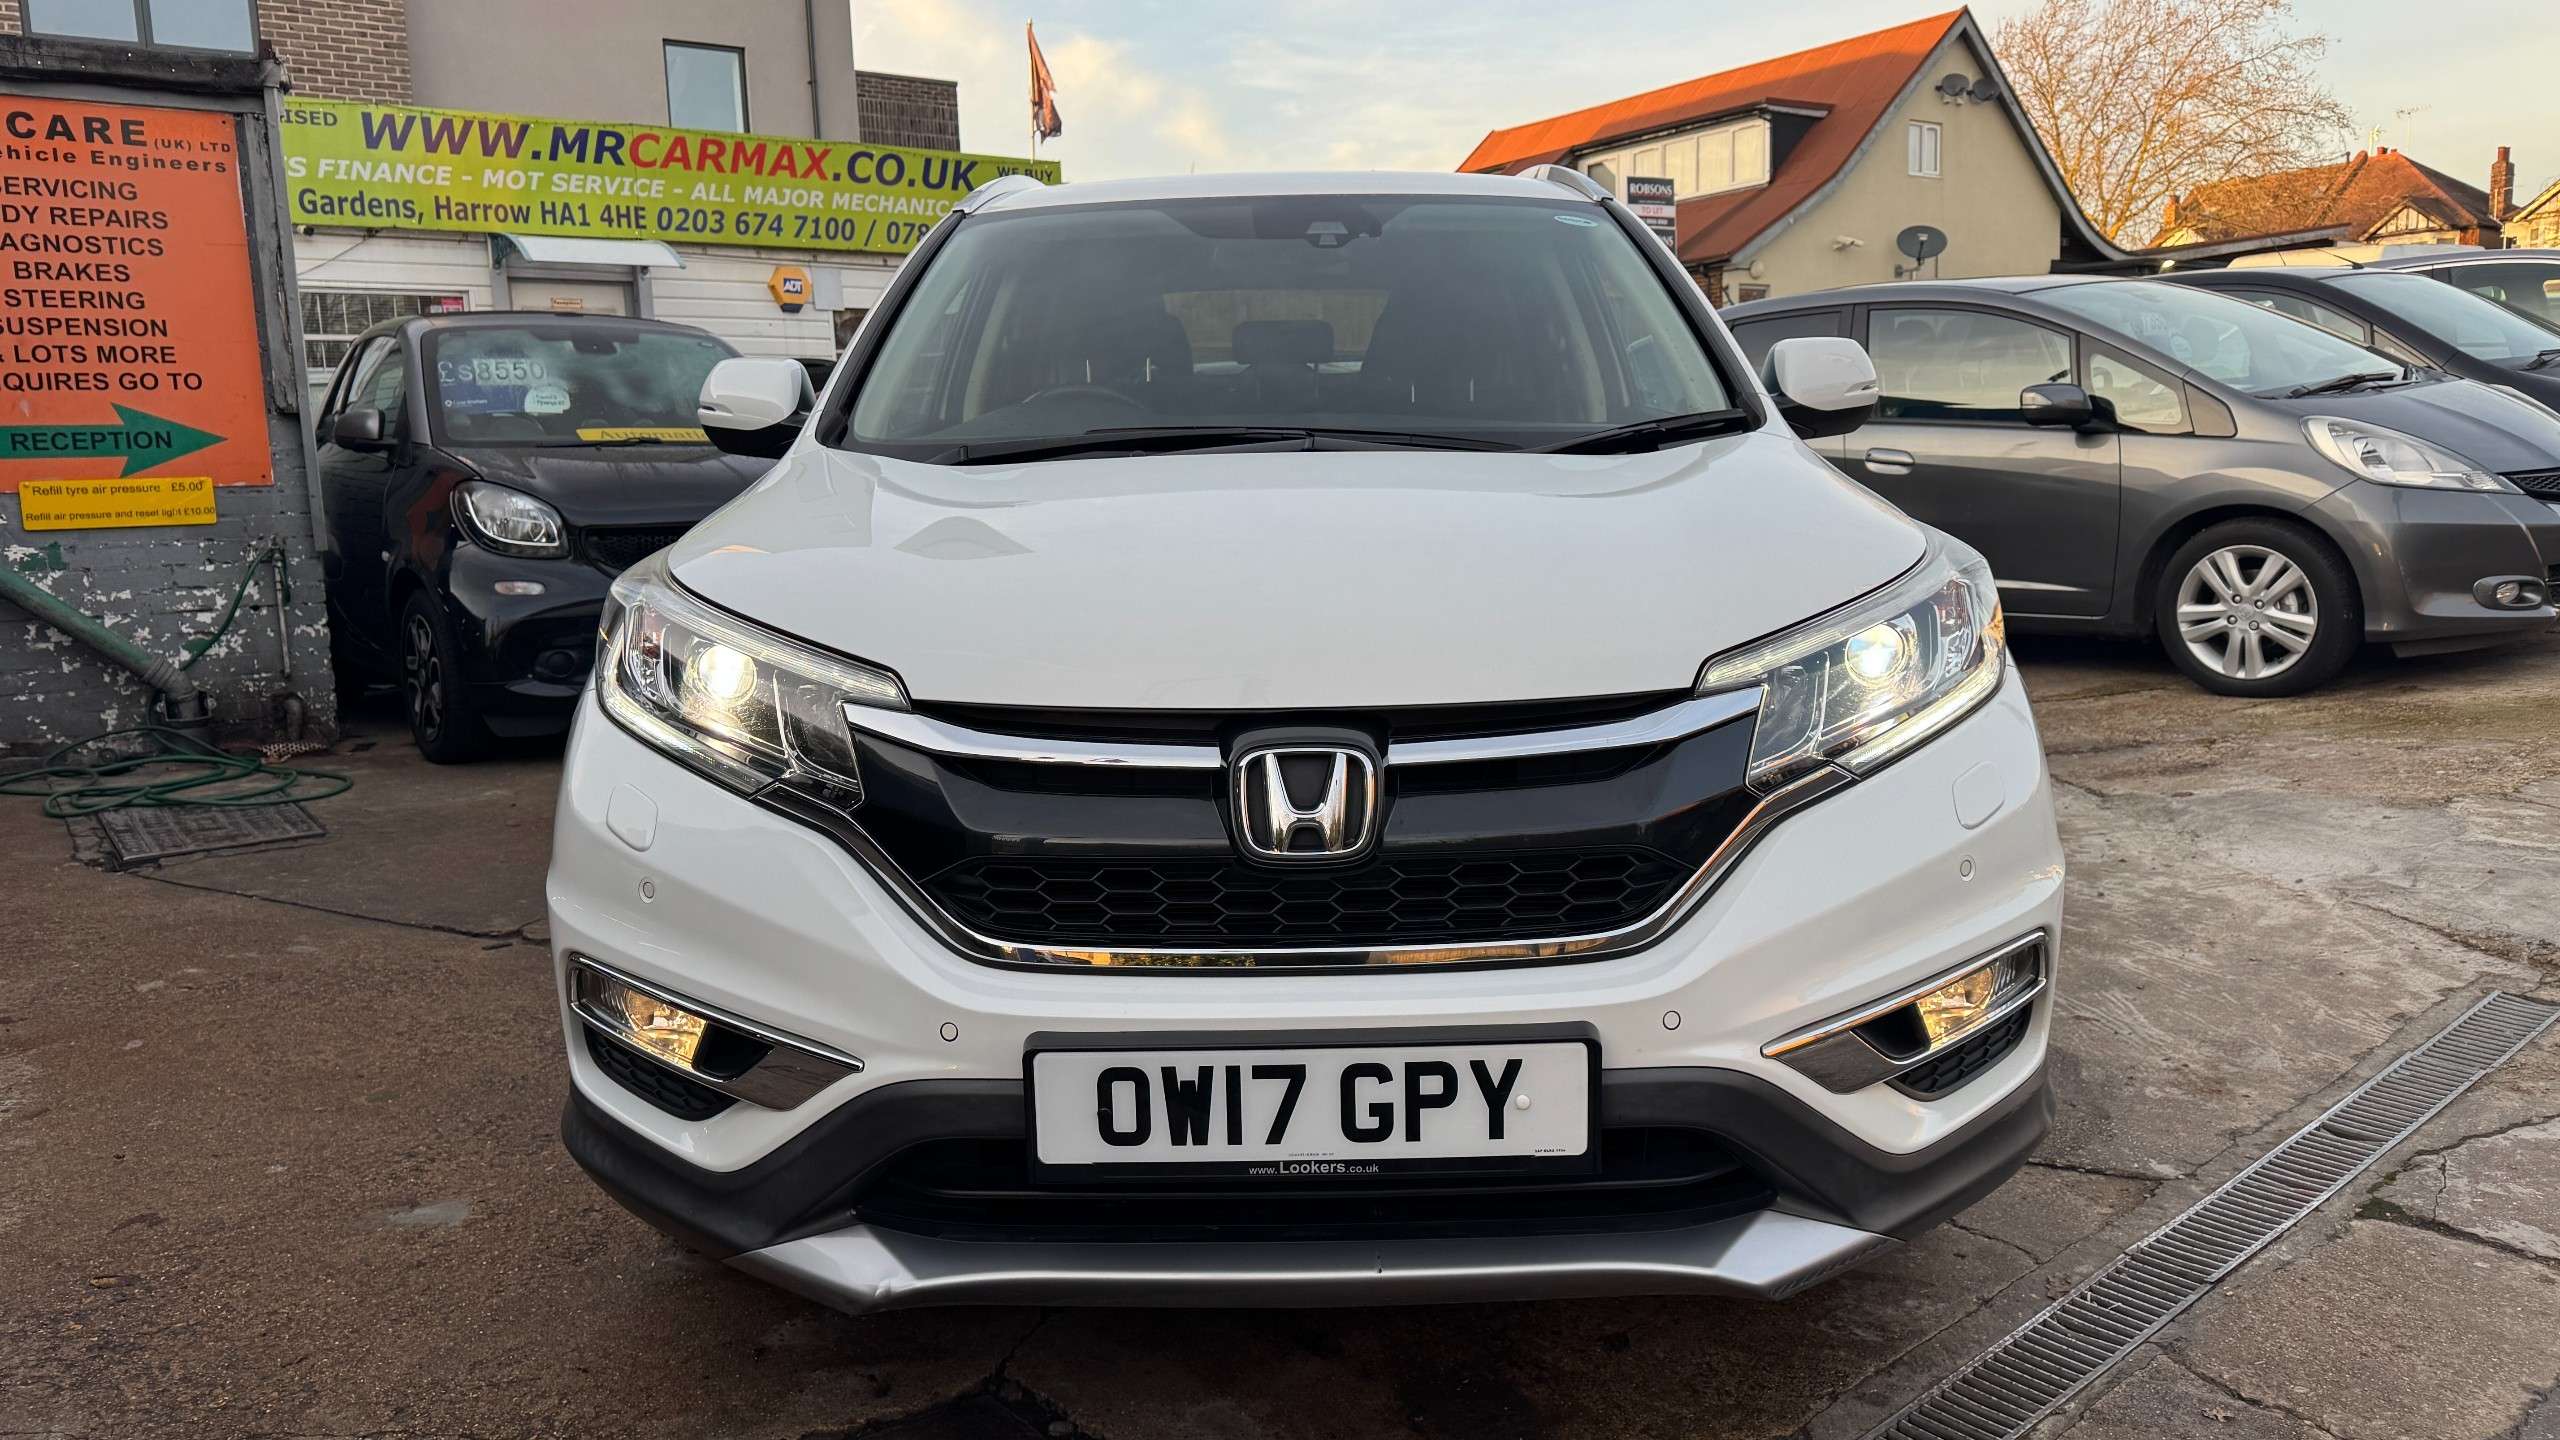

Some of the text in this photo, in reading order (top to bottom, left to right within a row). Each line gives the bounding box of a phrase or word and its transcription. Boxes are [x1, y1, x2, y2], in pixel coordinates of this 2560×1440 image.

[6, 111, 231, 153] CARE (UK) LTD
[0, 144, 227, 173] hicle Engineers
[361, 111, 979, 192] WWW.MRCARMAX.CO.UK
[0, 175, 138, 201] ERVICING
[318, 158, 453, 186] FINANCE
[482, 168, 545, 192] MOT
[551, 173, 665, 198] SERVICE
[690, 183, 735, 204] ALL
[744, 185, 824, 209] MAJOR
[1630, 182, 1673, 196] ROBSONS
[49, 206, 169, 230] REPAIRS
[299, 188, 424, 224] Gardens,
[434, 195, 531, 224] Harrow
[540, 201, 591, 227] HA1
[599, 205, 647, 230] 4HE
[657, 206, 725, 235] 0203
[735, 211, 784, 238] 674
[794, 214, 855, 242] 7100
[13, 260, 131, 283] BRAKES
[784, 279, 801, 293] ADT
[4, 288, 145, 310] STEERING
[13, 345, 87, 363] LOTS
[97, 345, 177, 364] MORE
[0, 372, 203, 392] QUIRES GO TO
[11, 431, 173, 451] RECEPTION
[32, 481, 204, 497] Refill tyre air pressure £5.00
[26, 512, 50, 522] Refill
[54, 511, 65, 521] air
[69, 510, 112, 522] pressure
[115, 509, 133, 519] and
[1097, 1058, 1523, 1147] OW17 GPY
[1249, 1160, 1379, 1176] www.Lookers.co.uk
